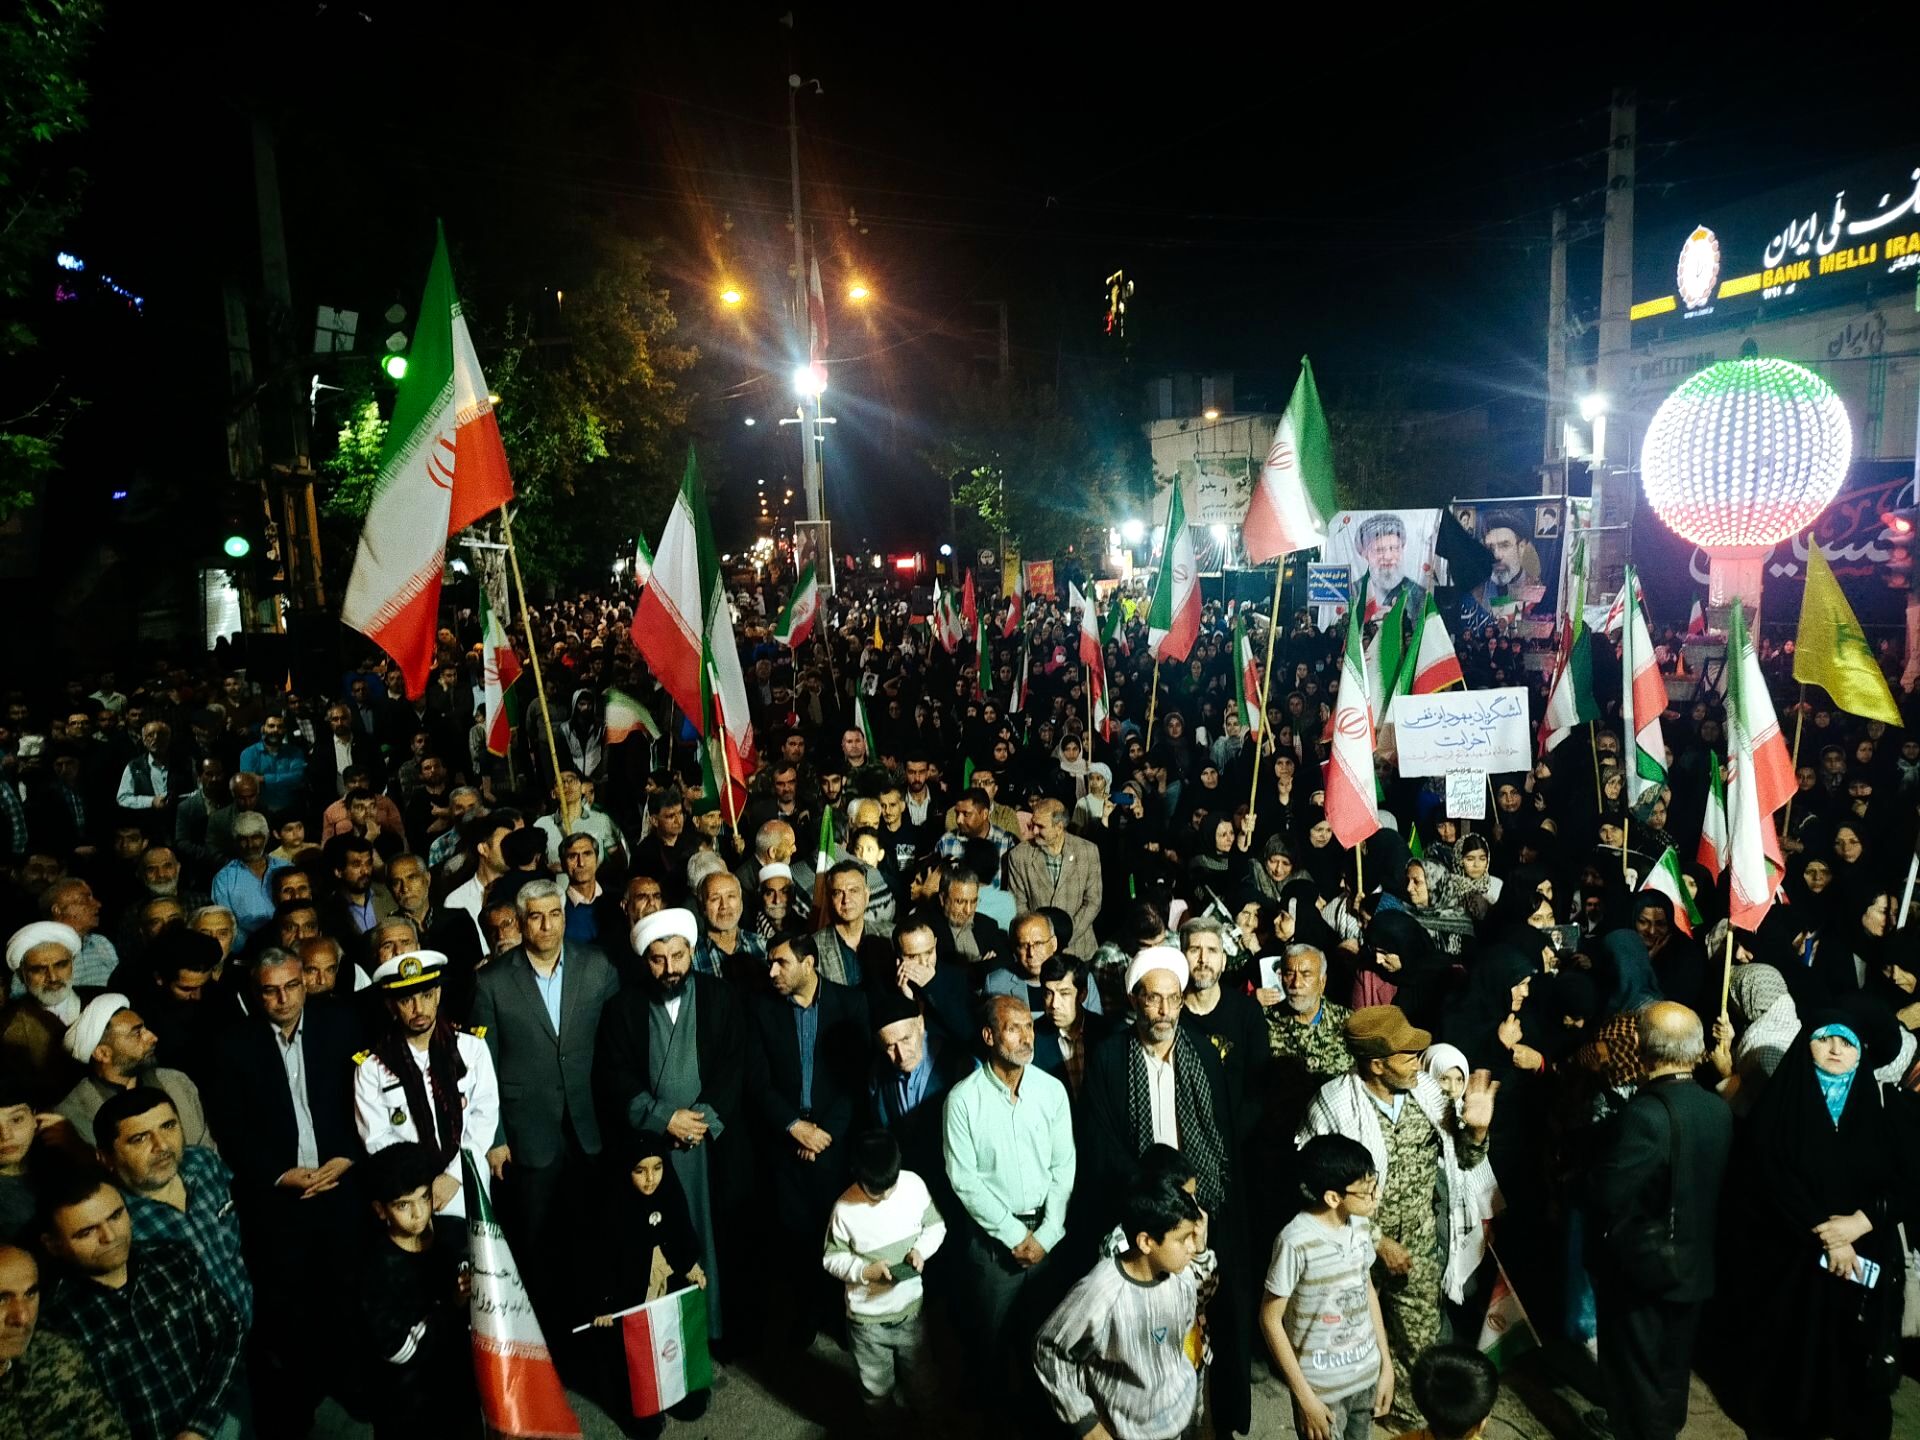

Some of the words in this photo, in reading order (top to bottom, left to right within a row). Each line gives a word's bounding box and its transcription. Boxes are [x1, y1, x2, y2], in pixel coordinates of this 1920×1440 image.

[1764, 212, 1817, 268] ایران
[1817, 190, 1846, 255] ملی
[1762, 259, 1811, 288] BANK
[1819, 243, 1877, 275] MELLI
[1885, 232, 1920, 259] IRA
